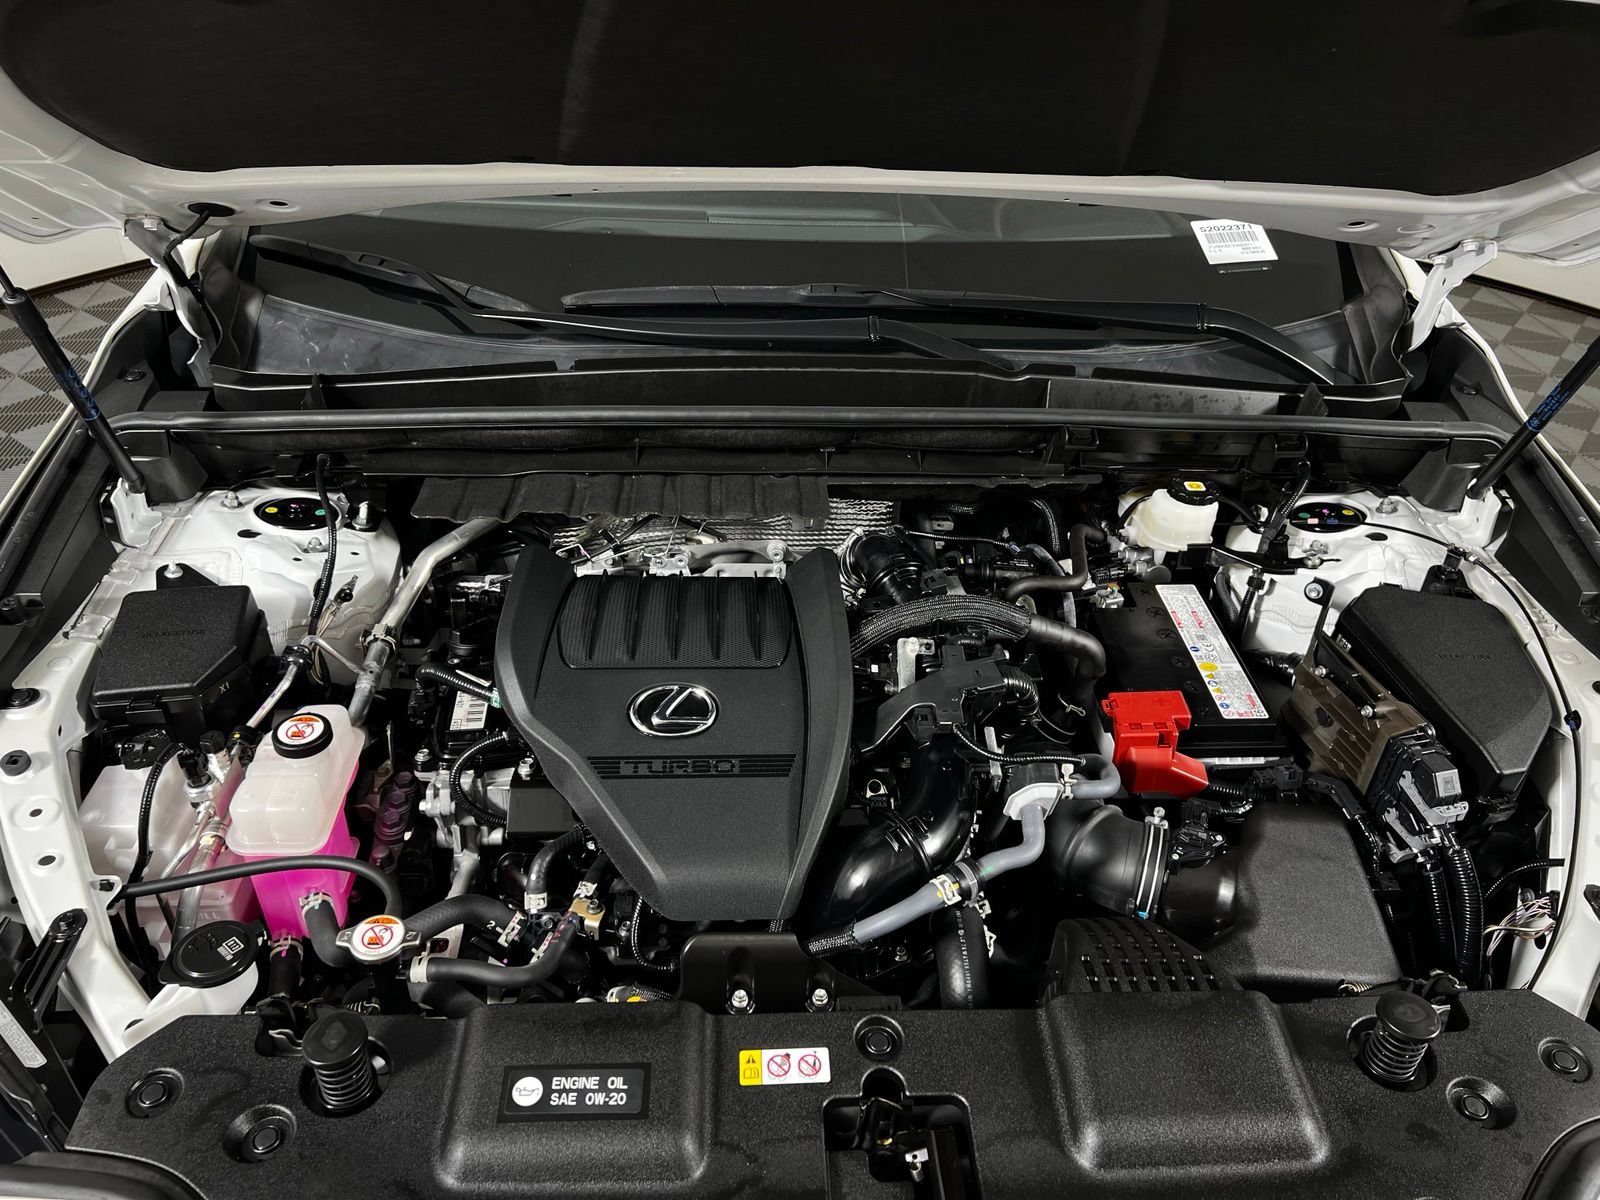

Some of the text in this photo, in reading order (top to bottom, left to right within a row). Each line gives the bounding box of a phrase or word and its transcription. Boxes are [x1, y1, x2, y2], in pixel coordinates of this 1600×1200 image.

[1199, 223, 1253, 233] S2022371
[219, 681, 231, 695] X1
[624, 760, 736, 774] TURBO
[551, 1076, 629, 1090] ENGINE OIL
[549, 1092, 627, 1106] SAE 0W-20
